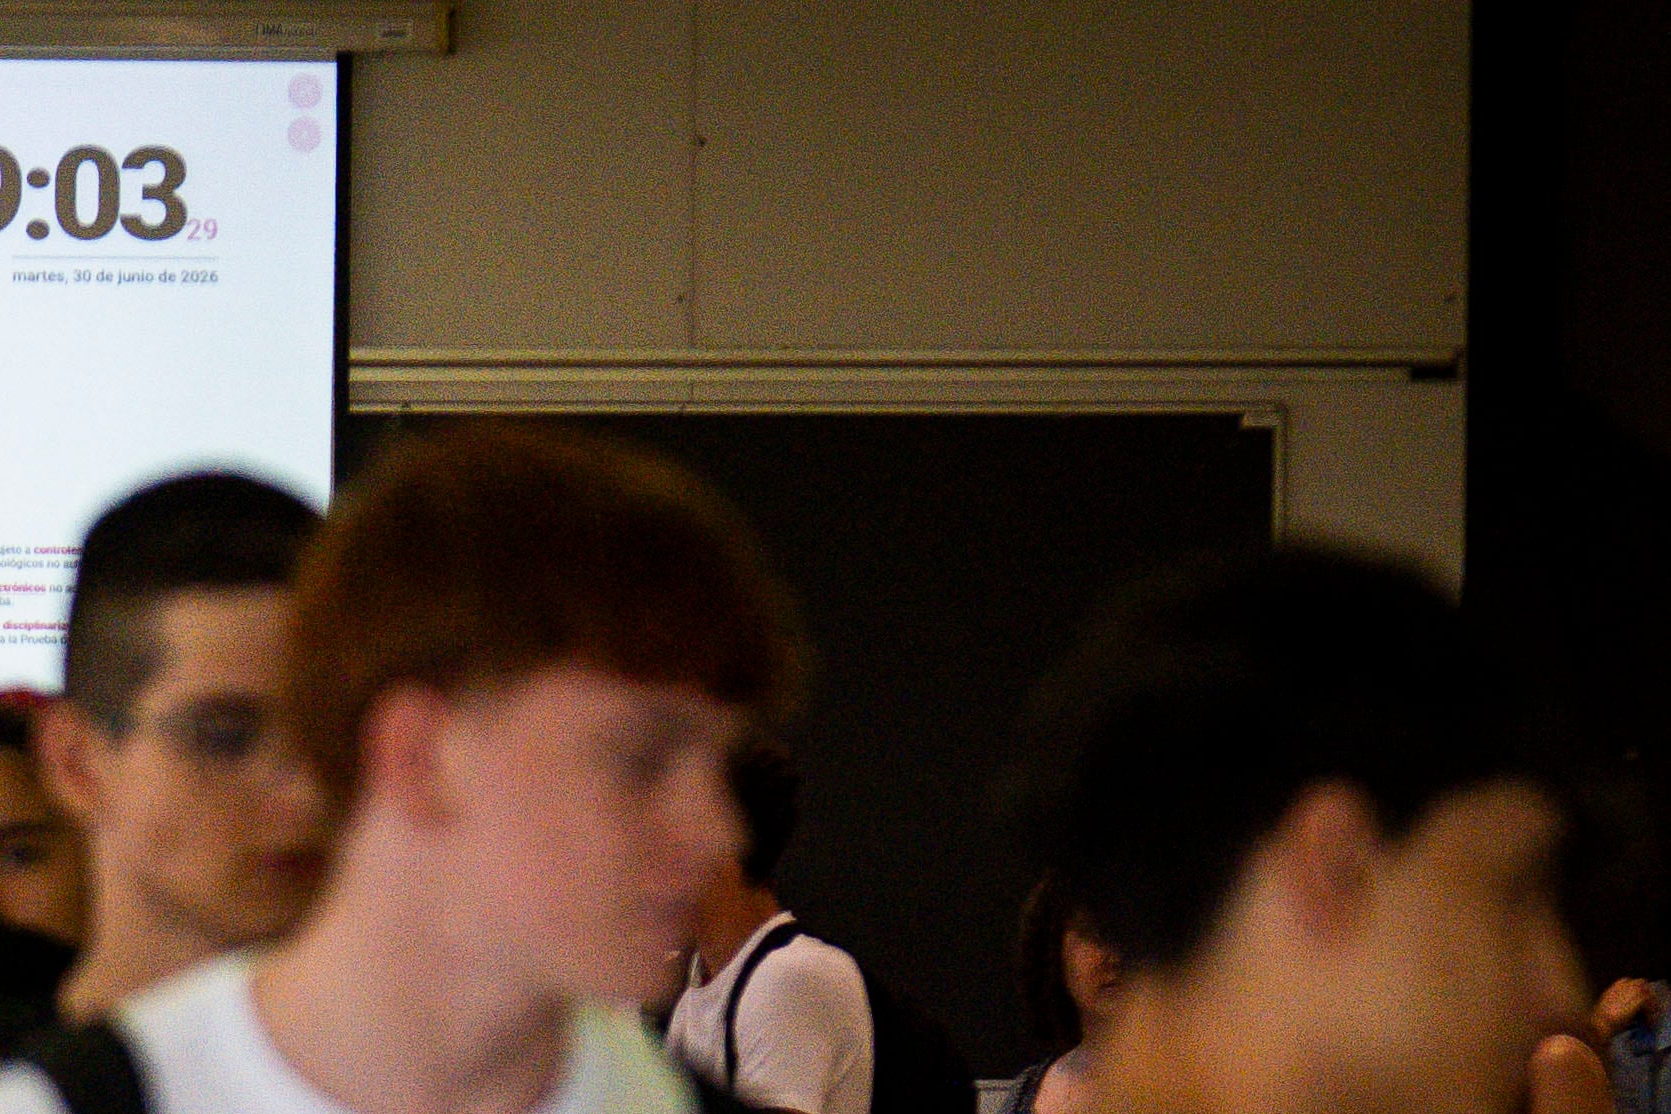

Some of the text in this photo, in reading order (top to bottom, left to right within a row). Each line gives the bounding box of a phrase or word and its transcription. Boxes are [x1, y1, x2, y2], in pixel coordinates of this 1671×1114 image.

[187, 219, 218, 241] 29
[12, 269, 218, 285] martes, 30 de junio de 2026
